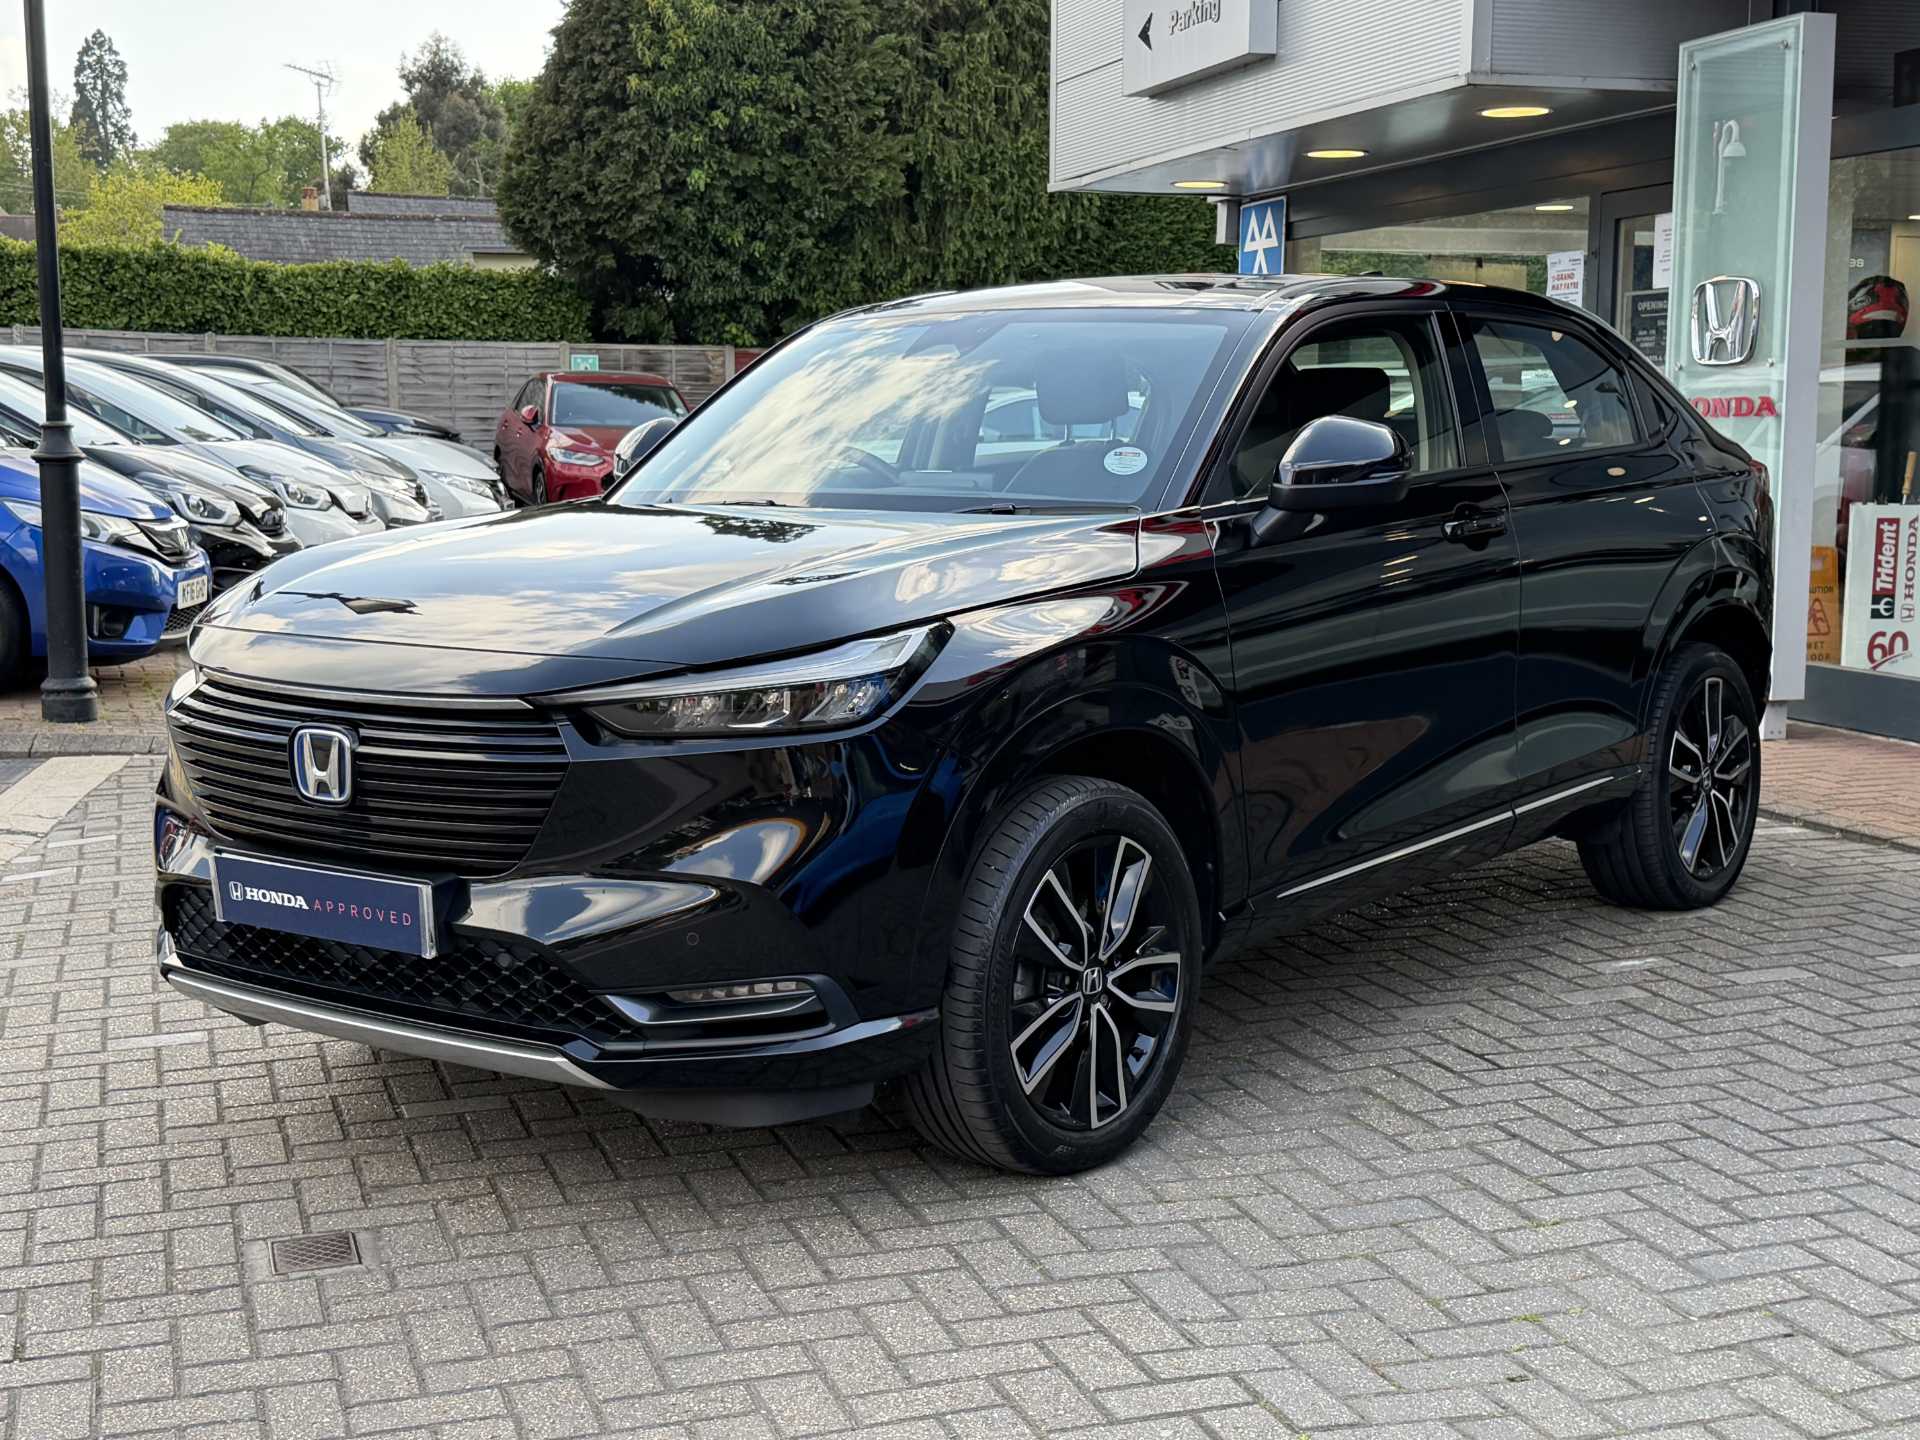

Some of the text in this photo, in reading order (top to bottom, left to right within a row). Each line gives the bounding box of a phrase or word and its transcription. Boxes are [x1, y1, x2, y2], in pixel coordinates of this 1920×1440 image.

[1168, 0, 1221, 35] Parking
[1691, 396, 1777, 417] ONDA
[1876, 521, 1897, 591] Trident
[1904, 514, 1919, 600] HONDA
[1867, 630, 1909, 667] 60
[245, 886, 310, 910] HONDA
[313, 899, 413, 926] APPROVED
